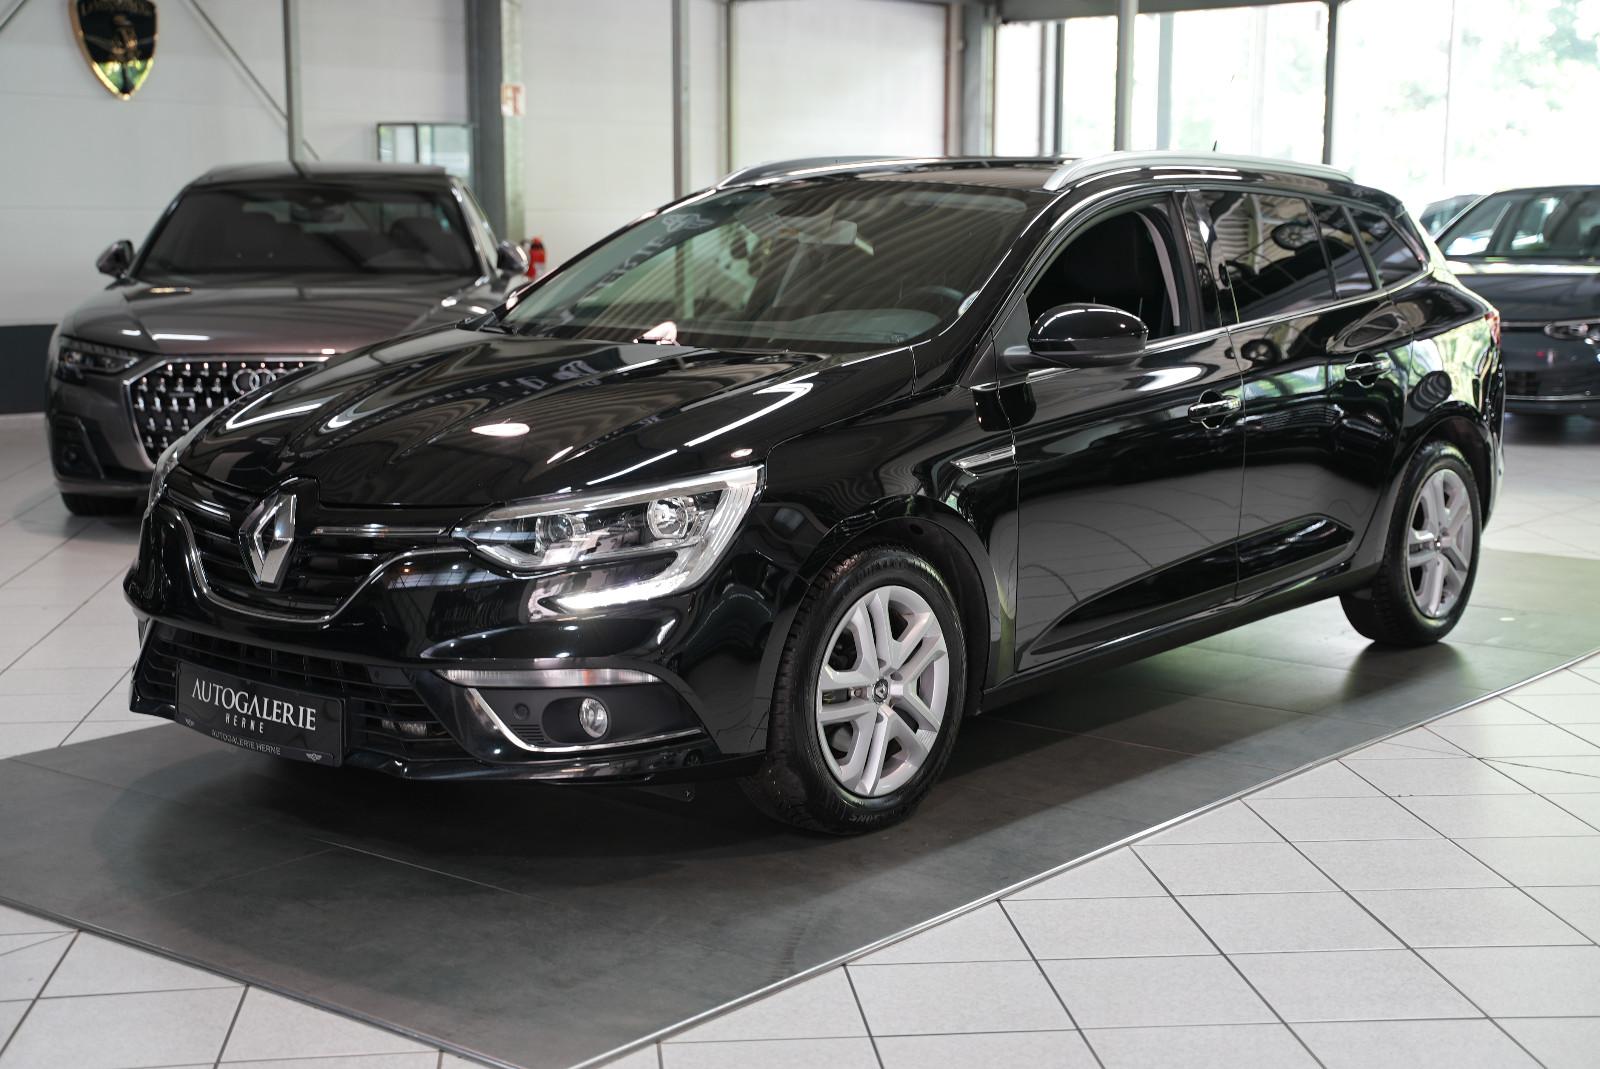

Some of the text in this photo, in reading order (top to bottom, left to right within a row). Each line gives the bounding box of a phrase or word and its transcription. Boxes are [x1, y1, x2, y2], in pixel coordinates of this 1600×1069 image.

[191, 677, 317, 731] AUTOGALERIE
[225, 713, 264, 734] HERNE
[211, 729, 281, 756] AUTOGALERIE HERNE
